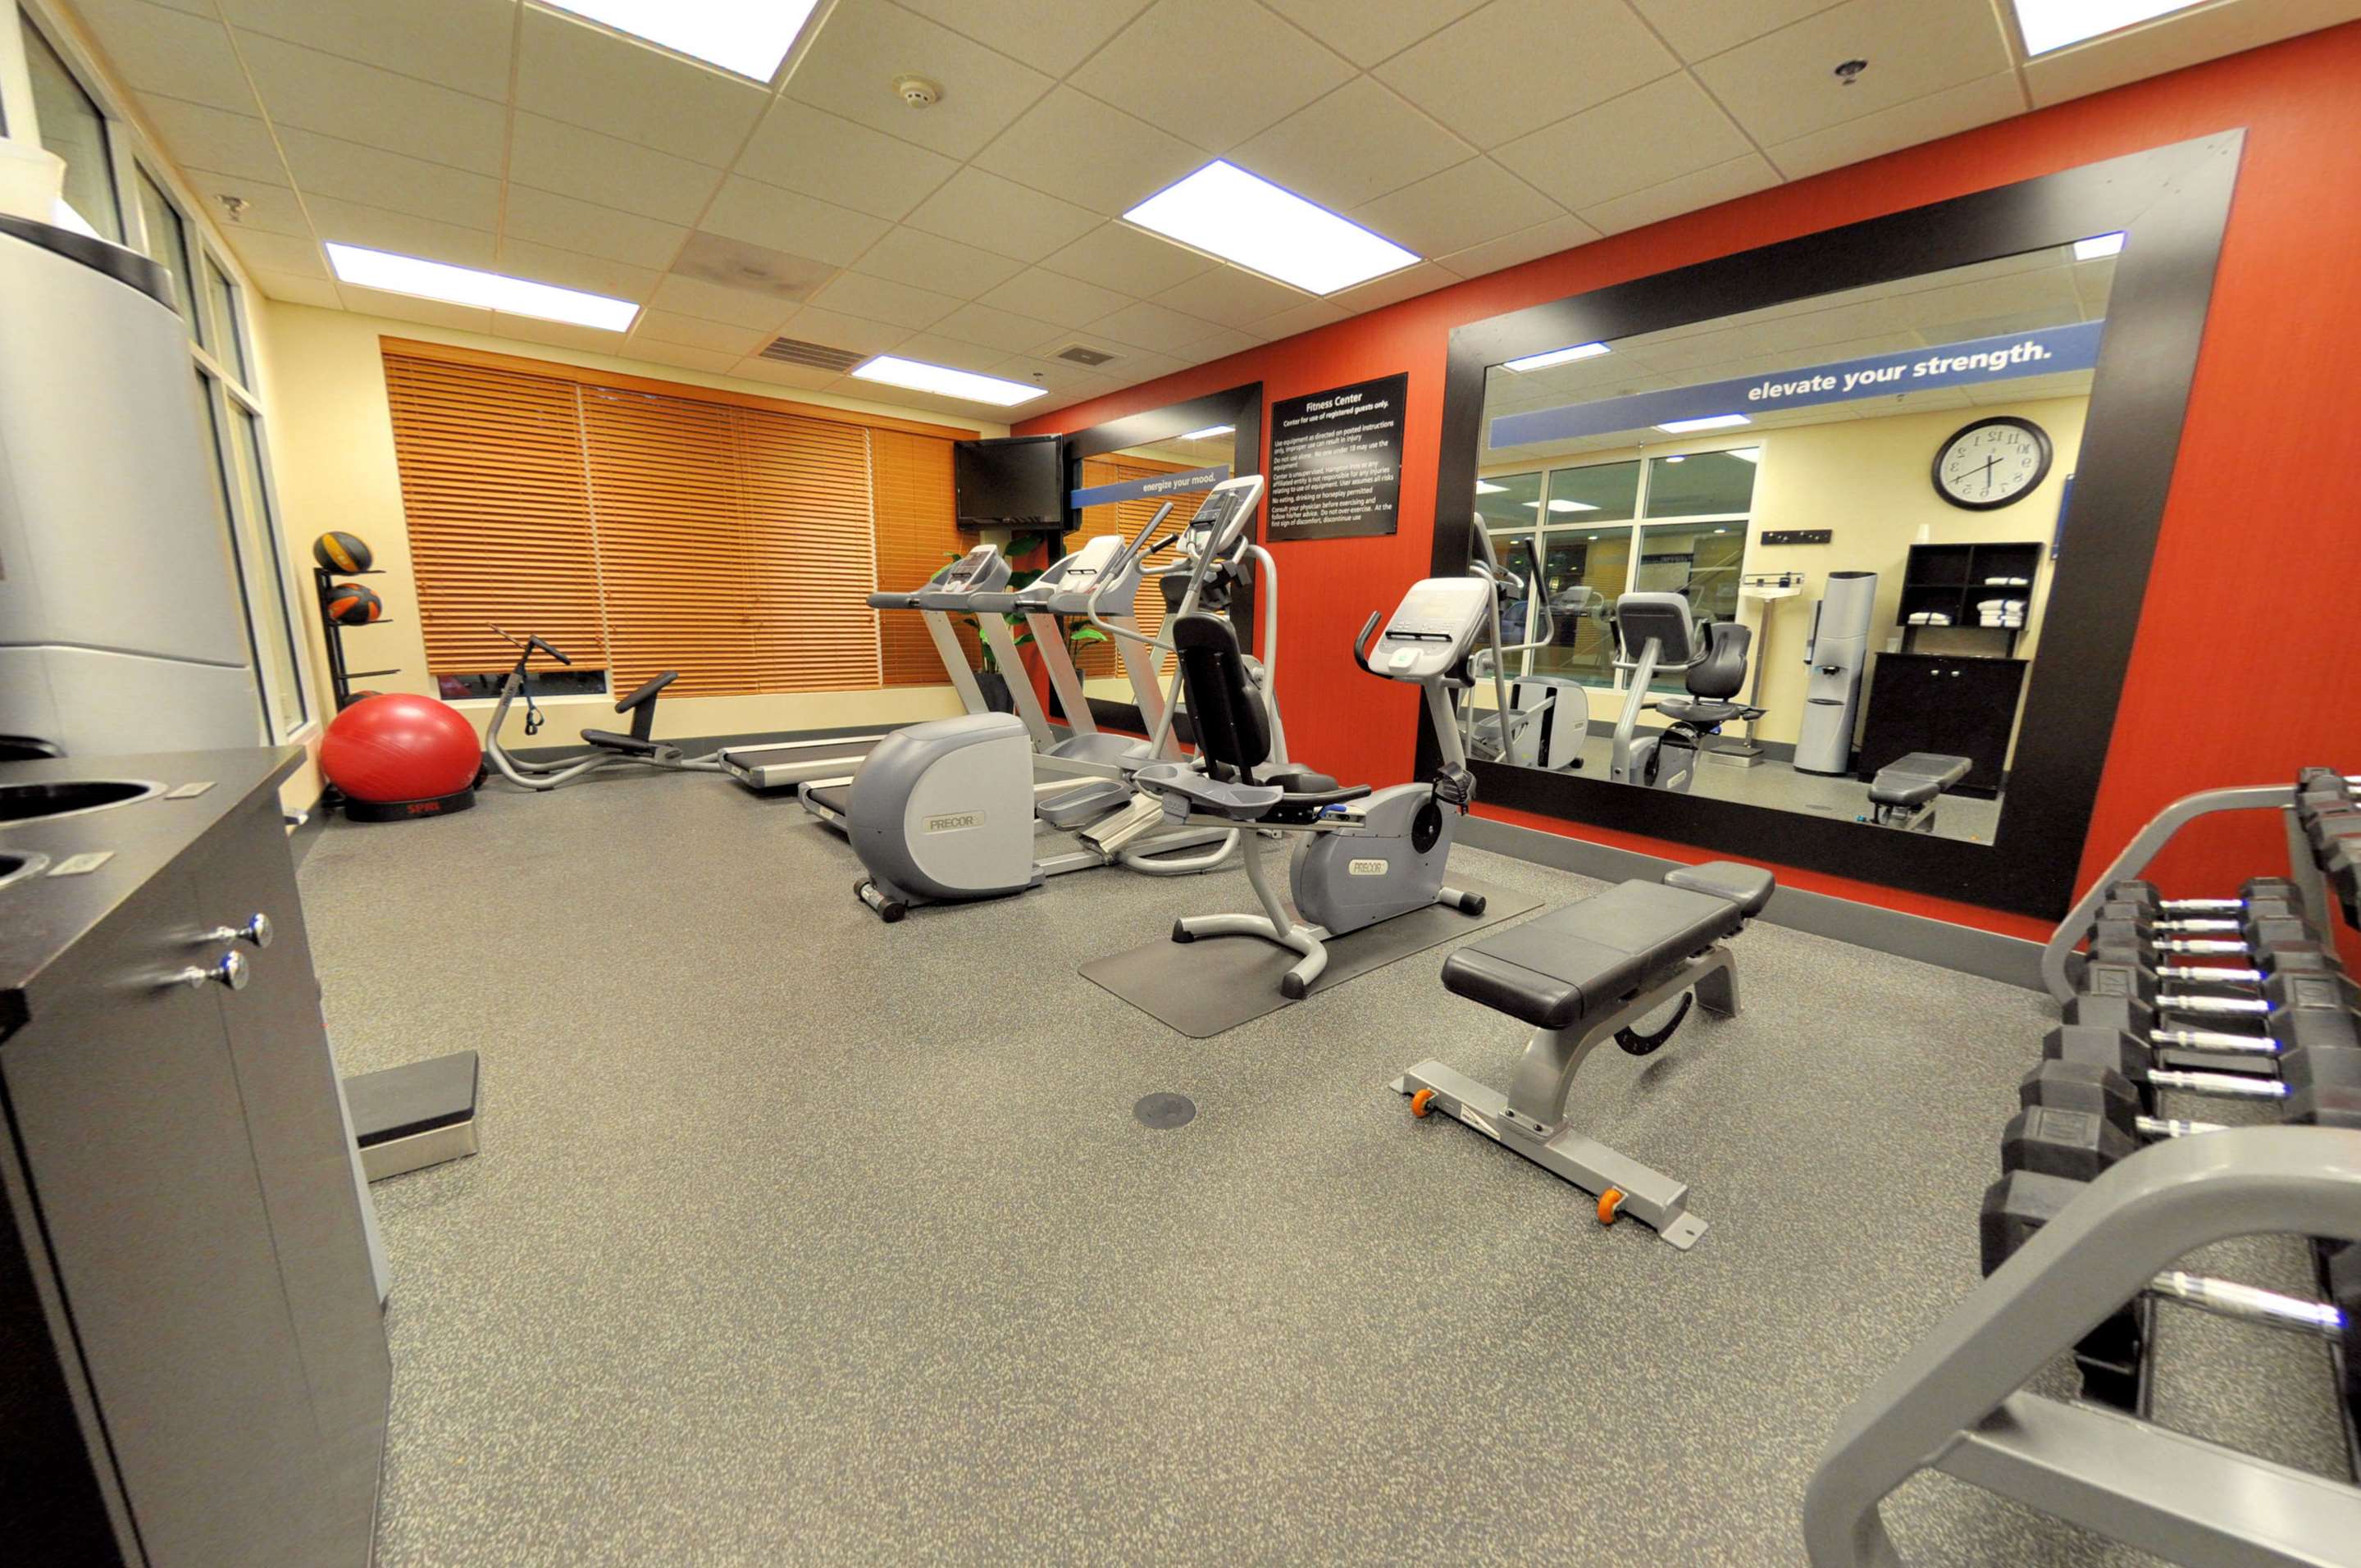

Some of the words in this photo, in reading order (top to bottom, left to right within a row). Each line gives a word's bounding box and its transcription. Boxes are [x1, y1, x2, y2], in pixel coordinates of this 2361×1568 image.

[1748, 374, 1837, 401] elevate
[1843, 364, 1907, 391] your
[1912, 341, 2052, 377] strength.
[1306, 399, 1333, 412] Fitness
[1334, 394, 1362, 406] Center
[1326, 407, 1353, 418] registered
[1355, 403, 1374, 414] guests
[1374, 400, 1388, 409] only.
[1283, 435, 1308, 445] equipment
[1315, 430, 1335, 440] directed
[1343, 425, 1361, 436] posted
[1362, 421, 1394, 431] instructions
[1325, 437, 1339, 445] result
[1347, 435, 1362, 443] injury
[1356, 444, 1368, 452] may
[1322, 472, 1349, 481] responsible
[1359, 469, 1369, 477] any
[1370, 467, 1390, 476] injuries
[1382, 473, 1393, 481] risks
[1143, 480, 1172, 492] energize
[1173, 477, 1190, 490] your
[1192, 472, 1215, 484] mood.
[1322, 490, 1346, 499] horseplay
[1347, 486, 1373, 497] permitted
[1288, 505, 1299, 513] your
[1300, 503, 1321, 512] physician
[1322, 500, 1338, 508] before
[1339, 498, 1365, 507] exercising
[1365, 495, 1376, 504] and
[1323, 515, 1352, 523] discontinue
[931, 816, 973, 829] PRECOR
